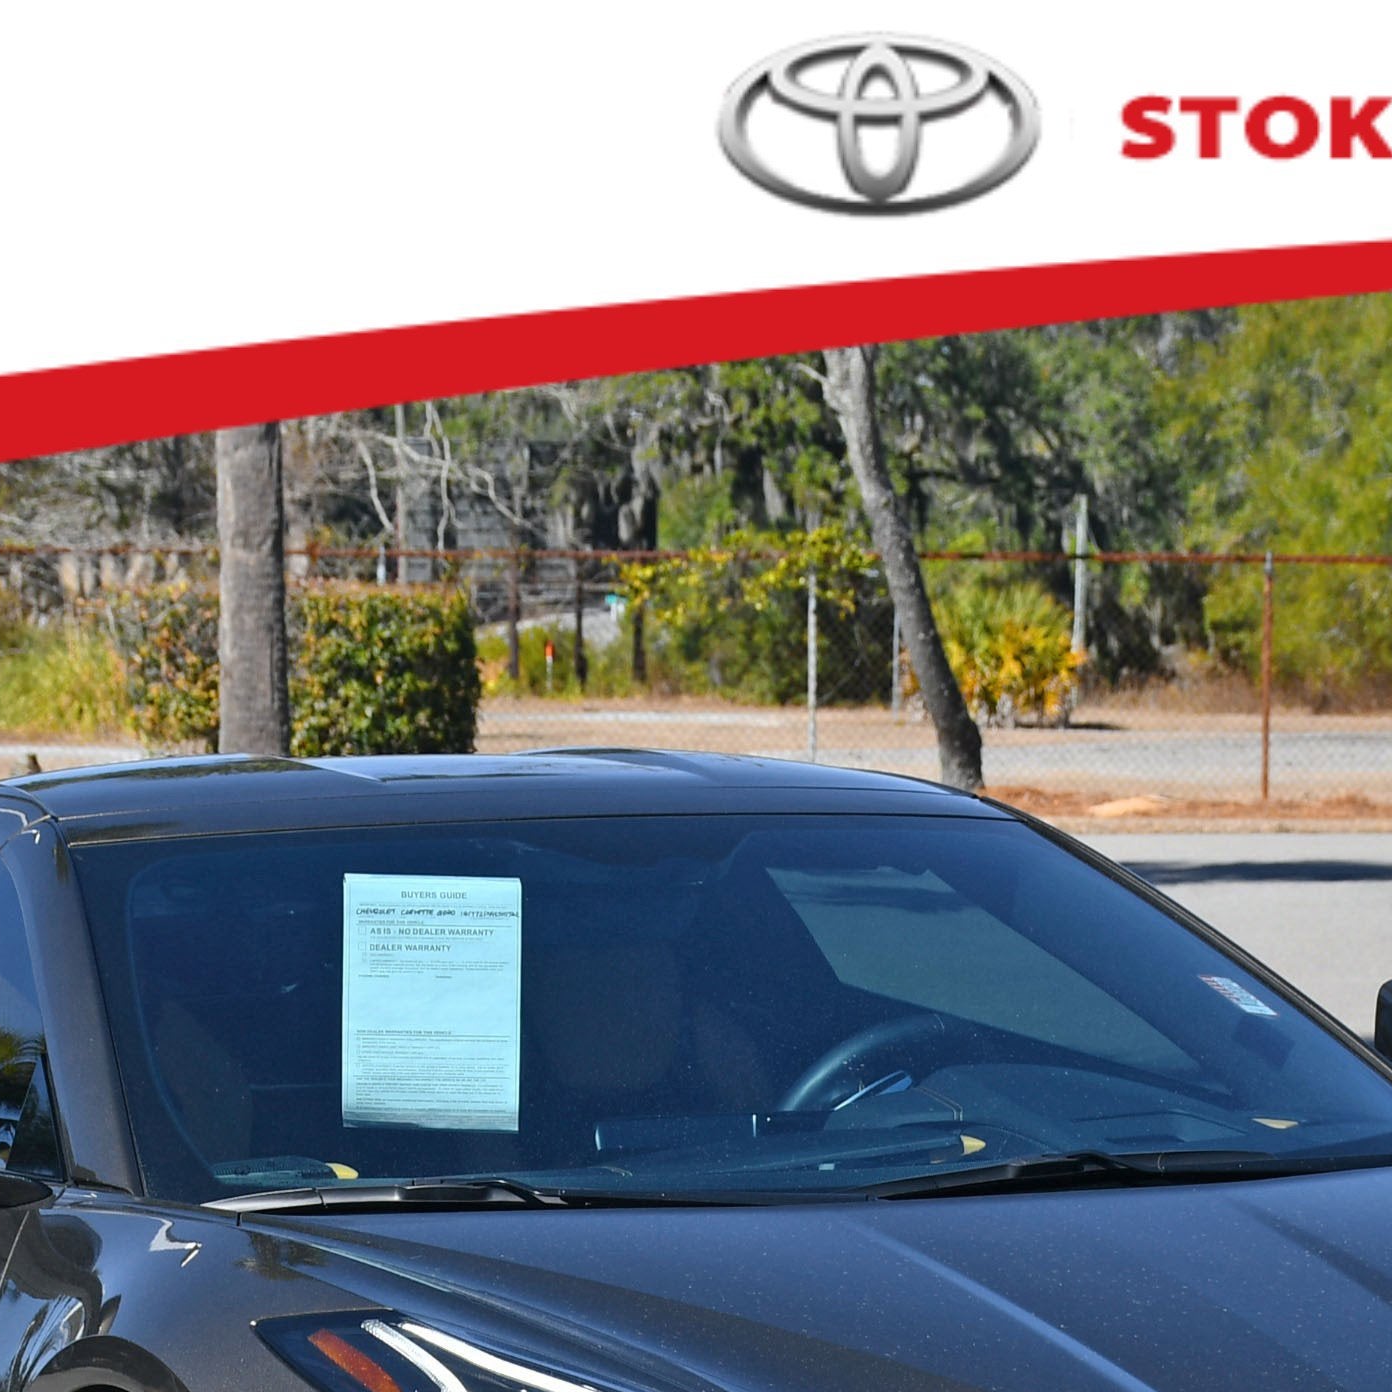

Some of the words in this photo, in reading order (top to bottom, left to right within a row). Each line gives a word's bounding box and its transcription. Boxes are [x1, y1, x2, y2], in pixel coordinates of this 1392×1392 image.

[400, 890, 437, 899] BUYERS
[439, 891, 468, 899] GUIDE
[370, 927, 382, 935] AS
[383, 927, 392, 935] IS
[398, 928, 411, 936] NO
[412, 928, 446, 936] DEALER
[447, 928, 495, 937] WARRANTY
[369, 943, 403, 952] DEALER
[404, 943, 452, 953] WARRANTY
